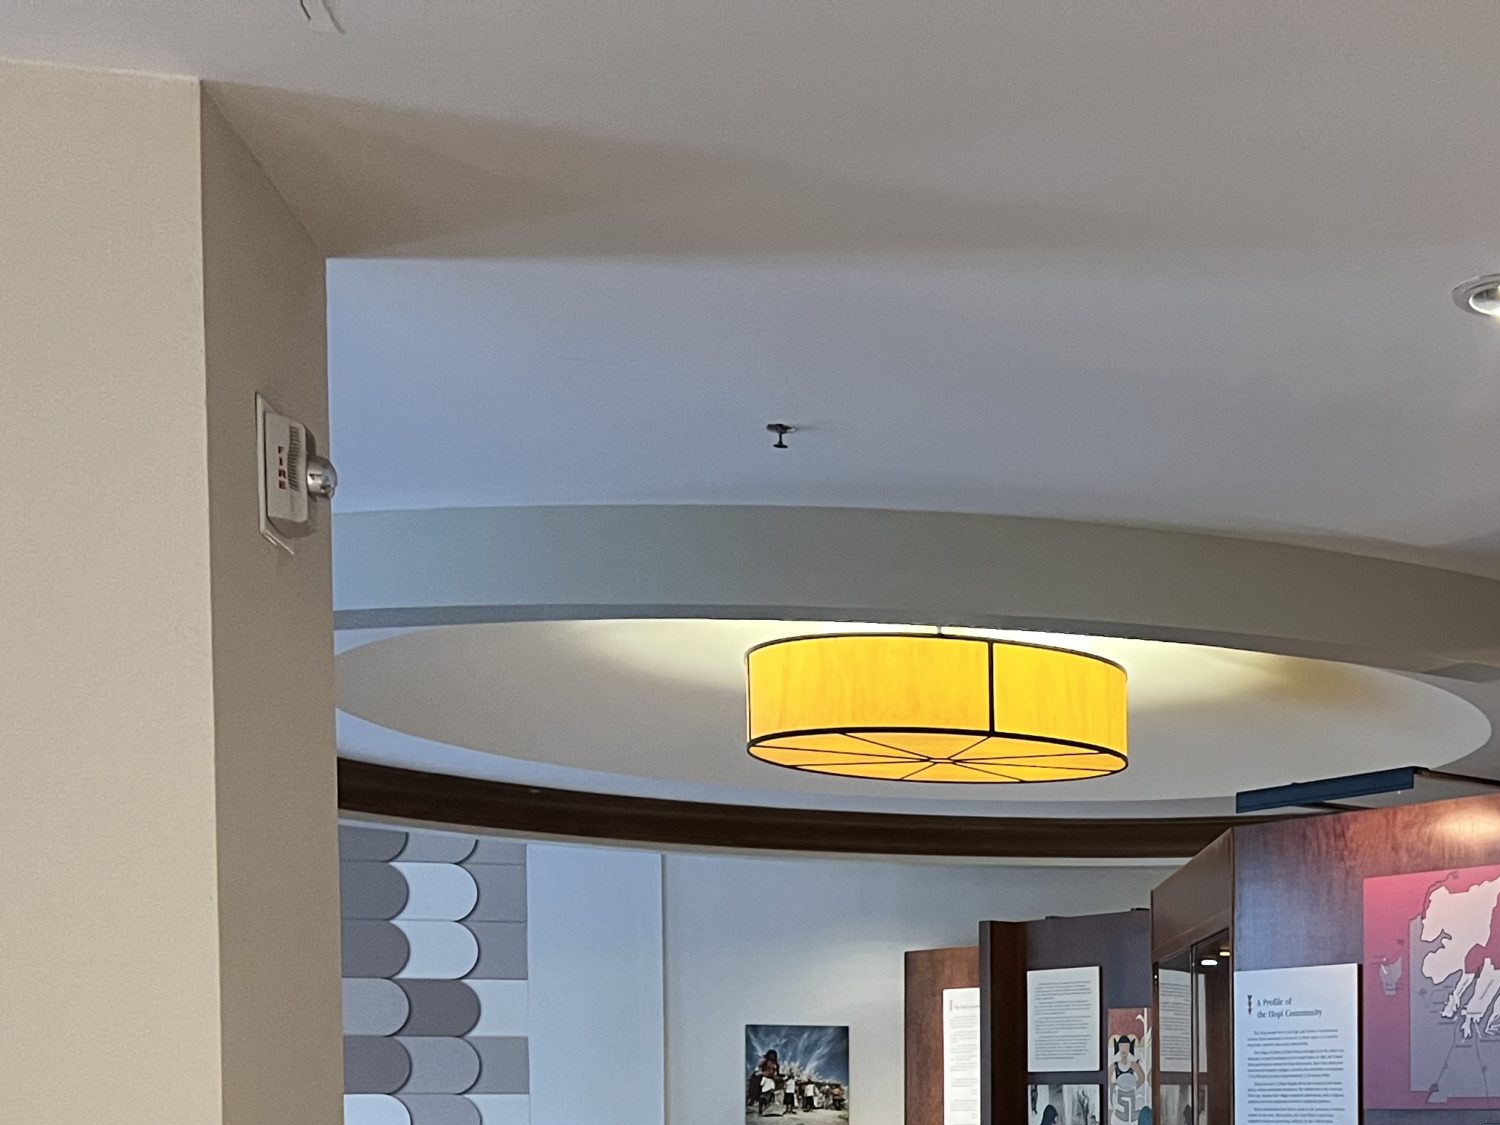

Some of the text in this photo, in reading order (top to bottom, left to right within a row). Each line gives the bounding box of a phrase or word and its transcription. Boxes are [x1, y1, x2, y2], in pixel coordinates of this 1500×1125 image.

[278, 446, 287, 490] FIRE
[1263, 998, 1283, 1006] Profile
[1285, 997, 1292, 1005] of
[1268, 1010, 1283, 1019] Hopi
